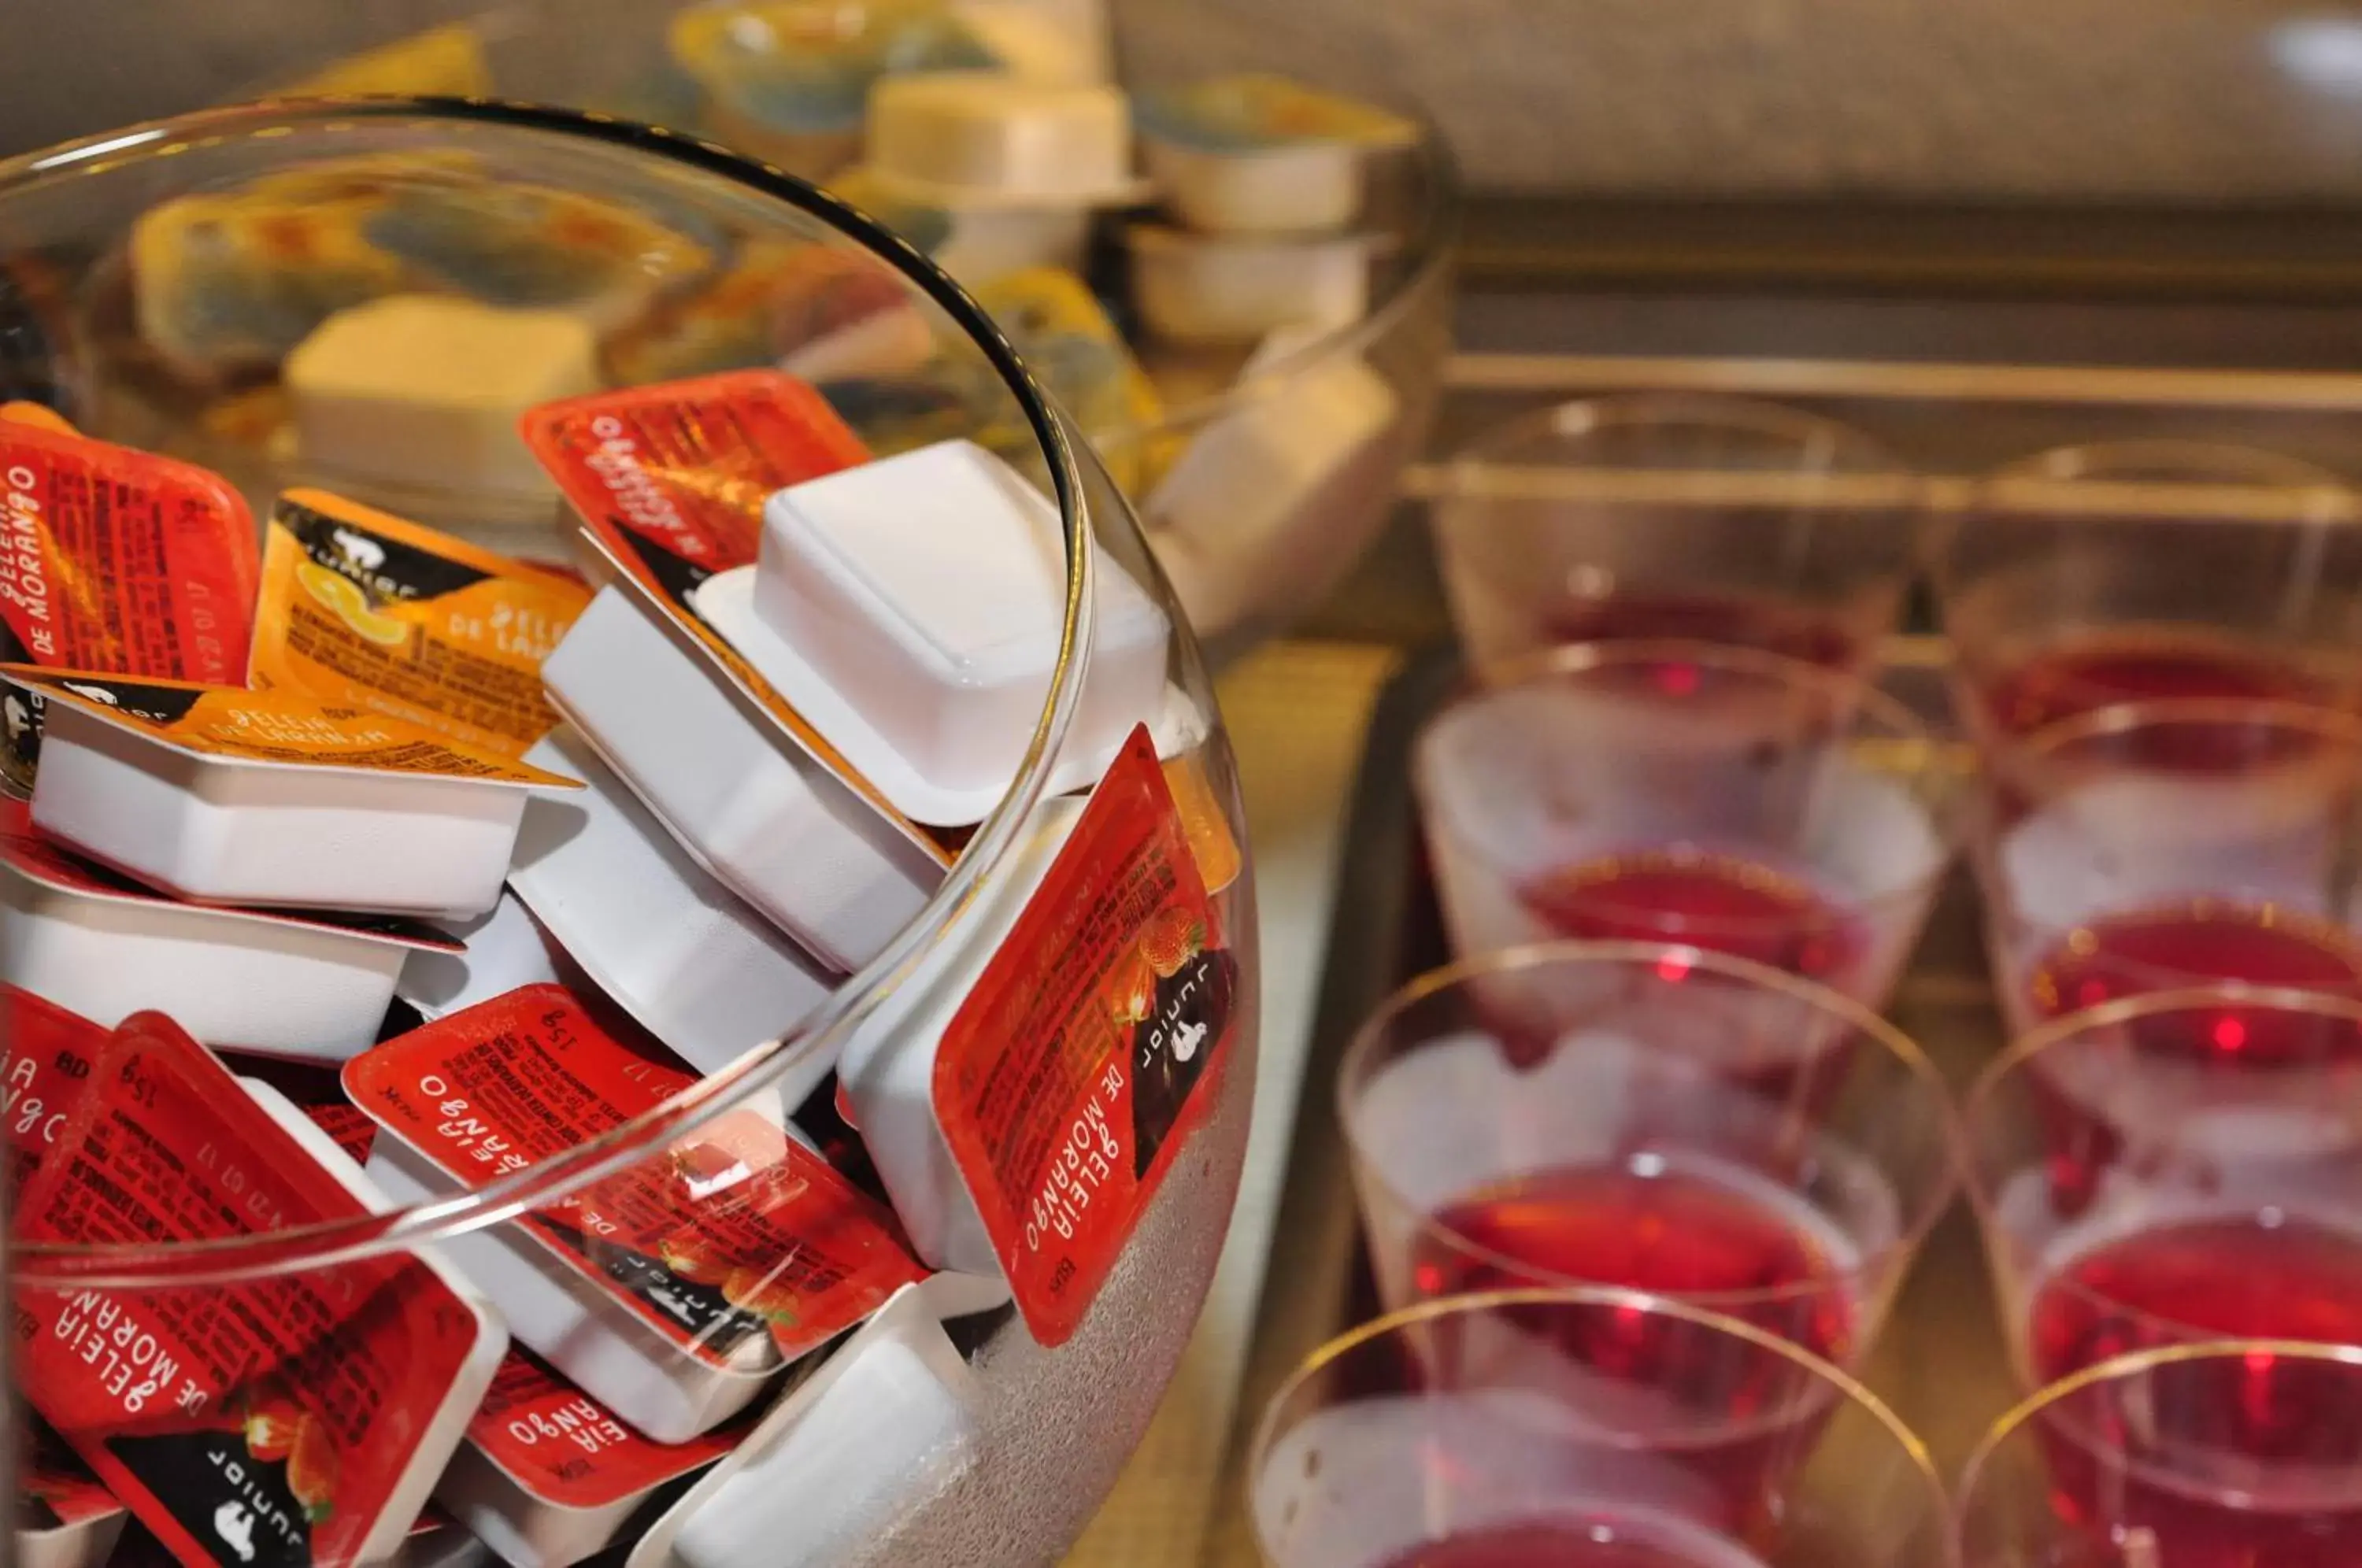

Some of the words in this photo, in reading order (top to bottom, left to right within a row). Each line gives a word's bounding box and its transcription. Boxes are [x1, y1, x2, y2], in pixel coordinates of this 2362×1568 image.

[29, 627, 56, 656] DE
[1101, 1063, 1125, 1103] DE
[583, 1210, 618, 1236] DE
[175, 1378, 209, 1418] DE
